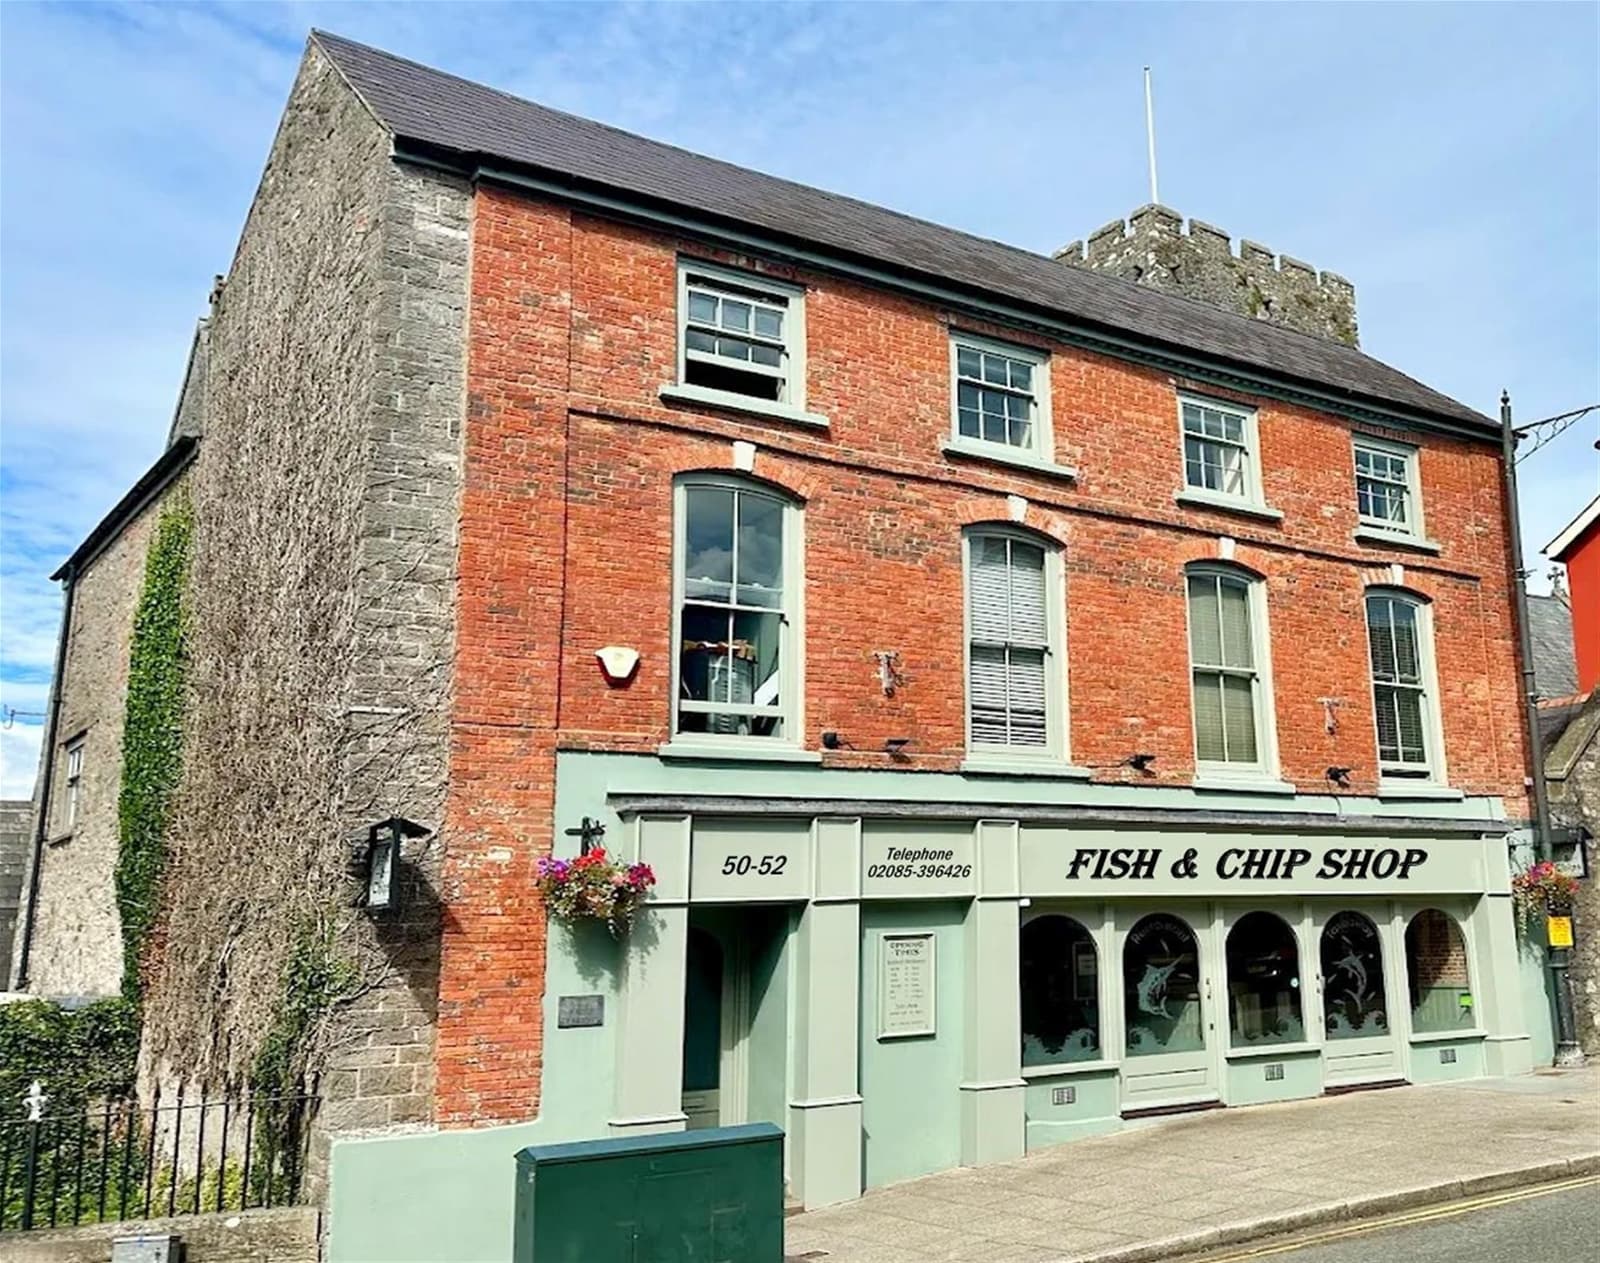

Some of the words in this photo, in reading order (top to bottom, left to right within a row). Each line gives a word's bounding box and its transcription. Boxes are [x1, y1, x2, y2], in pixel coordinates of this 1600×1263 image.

[887, 847, 954, 864] Telephone
[1065, 848, 1163, 880] FISH
[1171, 847, 1199, 879] &
[1216, 848, 1312, 880] CHIP
[1316, 848, 1429, 880] SHOP
[722, 855, 788, 876] 50-52
[868, 864, 972, 879] 02085-396426
